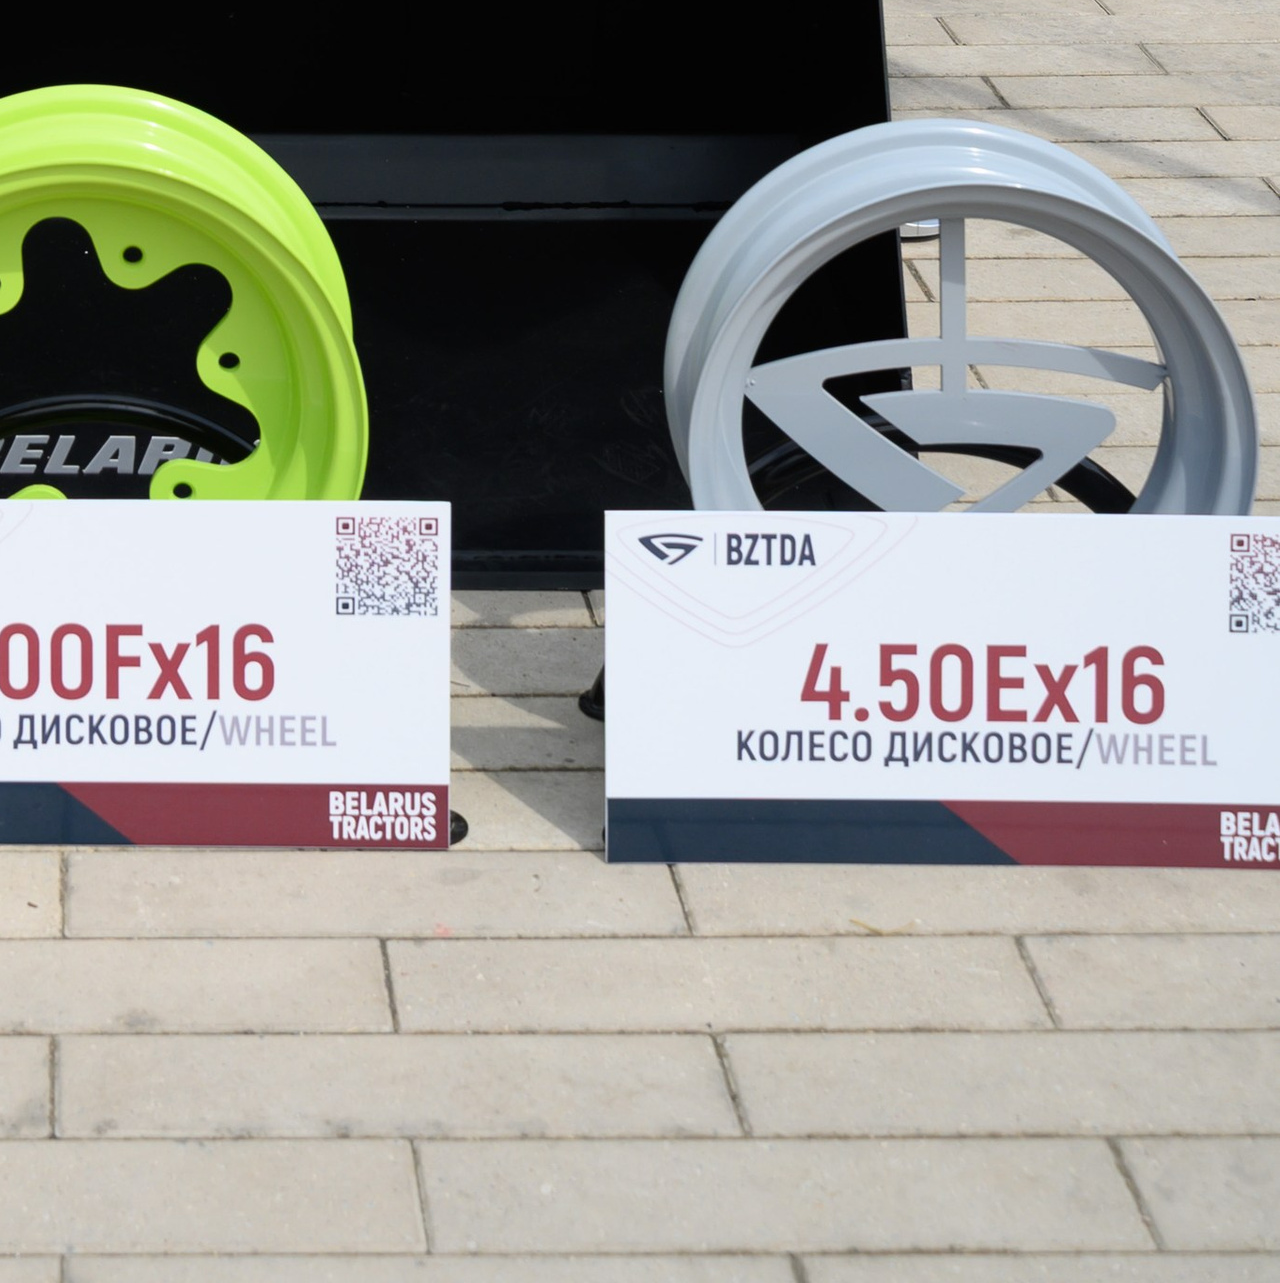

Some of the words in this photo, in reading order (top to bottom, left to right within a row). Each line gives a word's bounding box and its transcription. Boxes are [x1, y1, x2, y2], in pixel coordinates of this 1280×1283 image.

[726, 533, 817, 567] BZTDA
[800, 643, 1166, 725] 4.50Ex16
[12, 709, 338, 751] ДИСКОВОЕ/WHEEL
[736, 730, 872, 763] КОЛЕСО
[883, 728, 1218, 770] ДИСКОВОЕ/WHEEL
[328, 791, 437, 817] BELARUS
[328, 815, 437, 842] TRACTORS
